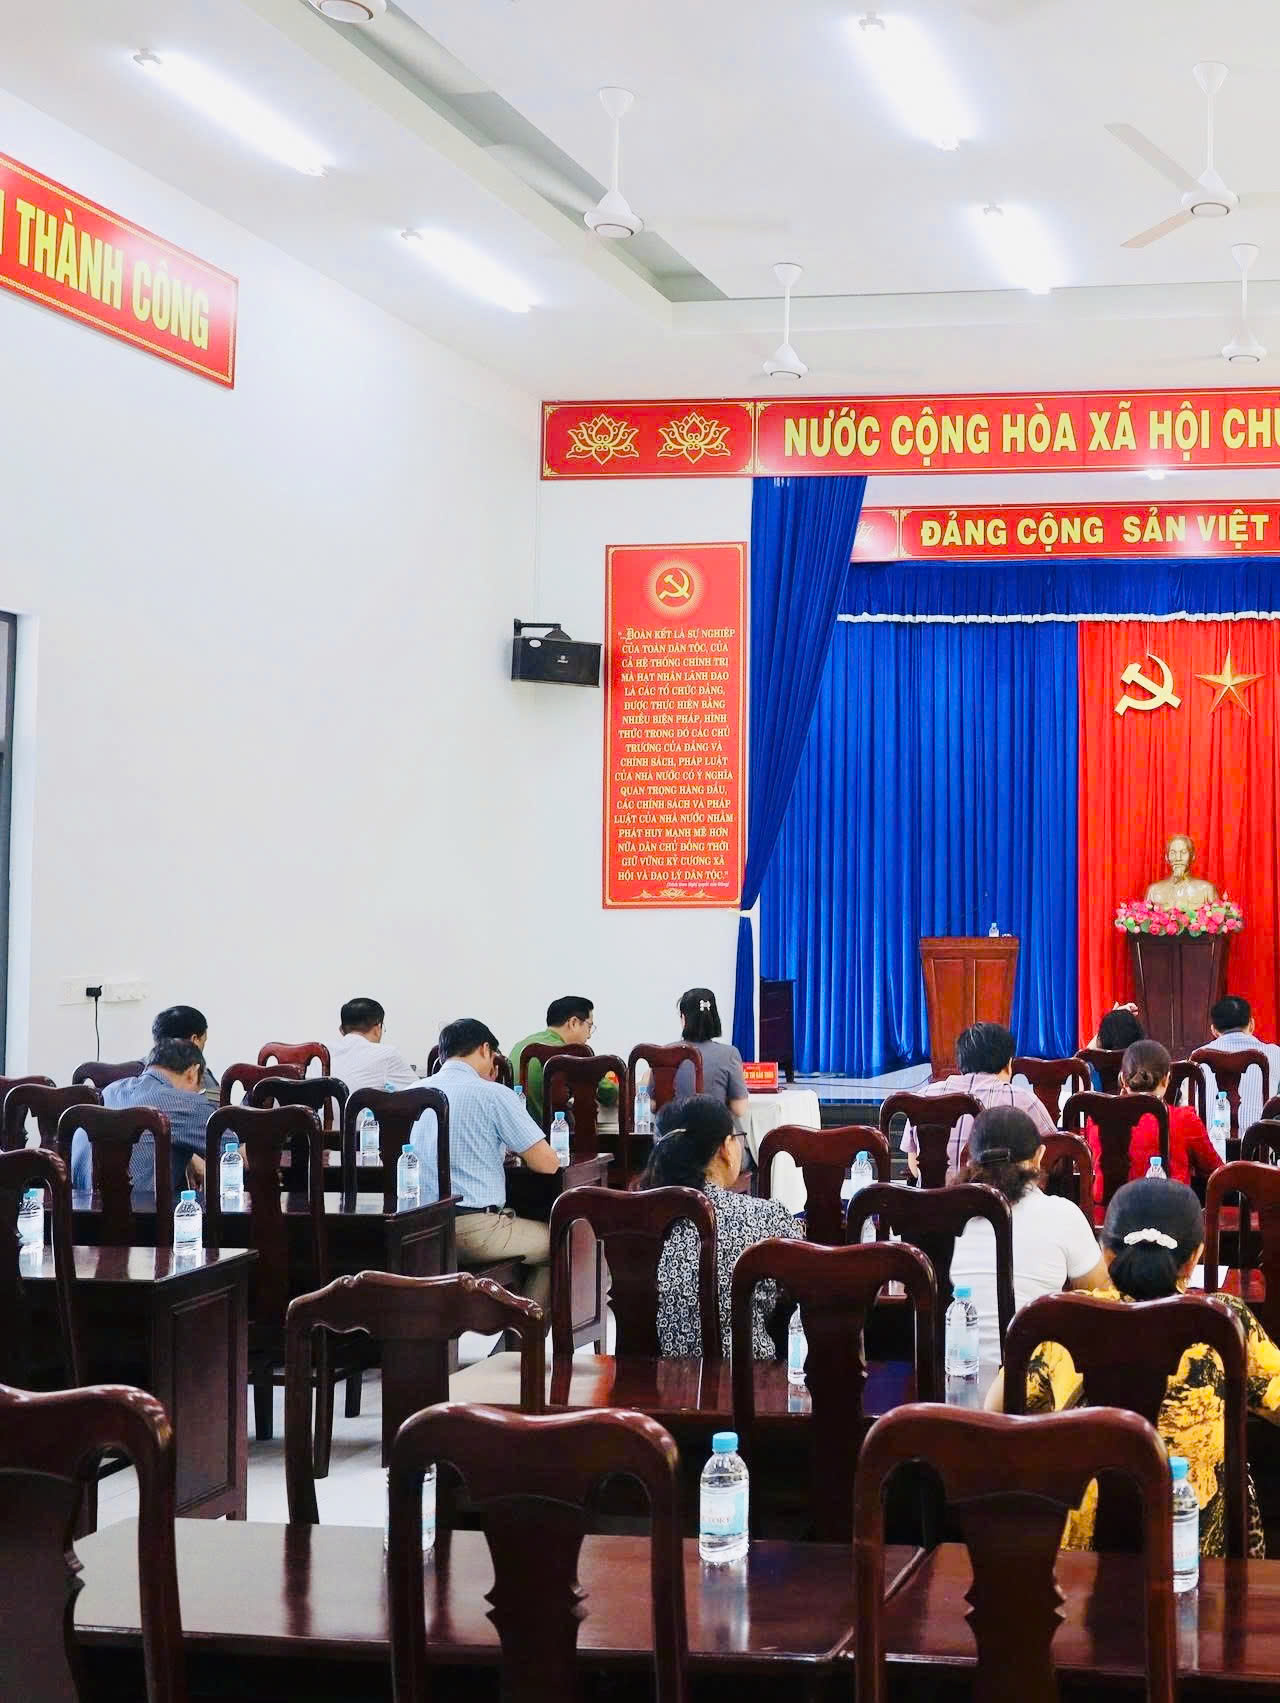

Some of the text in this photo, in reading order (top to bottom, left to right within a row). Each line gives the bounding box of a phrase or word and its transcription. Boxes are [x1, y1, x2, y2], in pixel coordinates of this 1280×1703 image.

[16, 198, 124, 310] THÀNH
[132, 258, 209, 350] CÔNG
[784, 406, 881, 457] NƯỚC
[890, 406, 990, 467] CỘNG
[1002, 402, 1078, 453] HÒA
[1088, 400, 1137, 451] XÃ
[1149, 400, 1210, 462] HỘI
[920, 510, 1007, 546] ĐẢNG
[1017, 511, 1104, 552] CỘNG
[1123, 506, 1186, 543] SẢN
[1197, 508, 1269, 549] VIỆT
